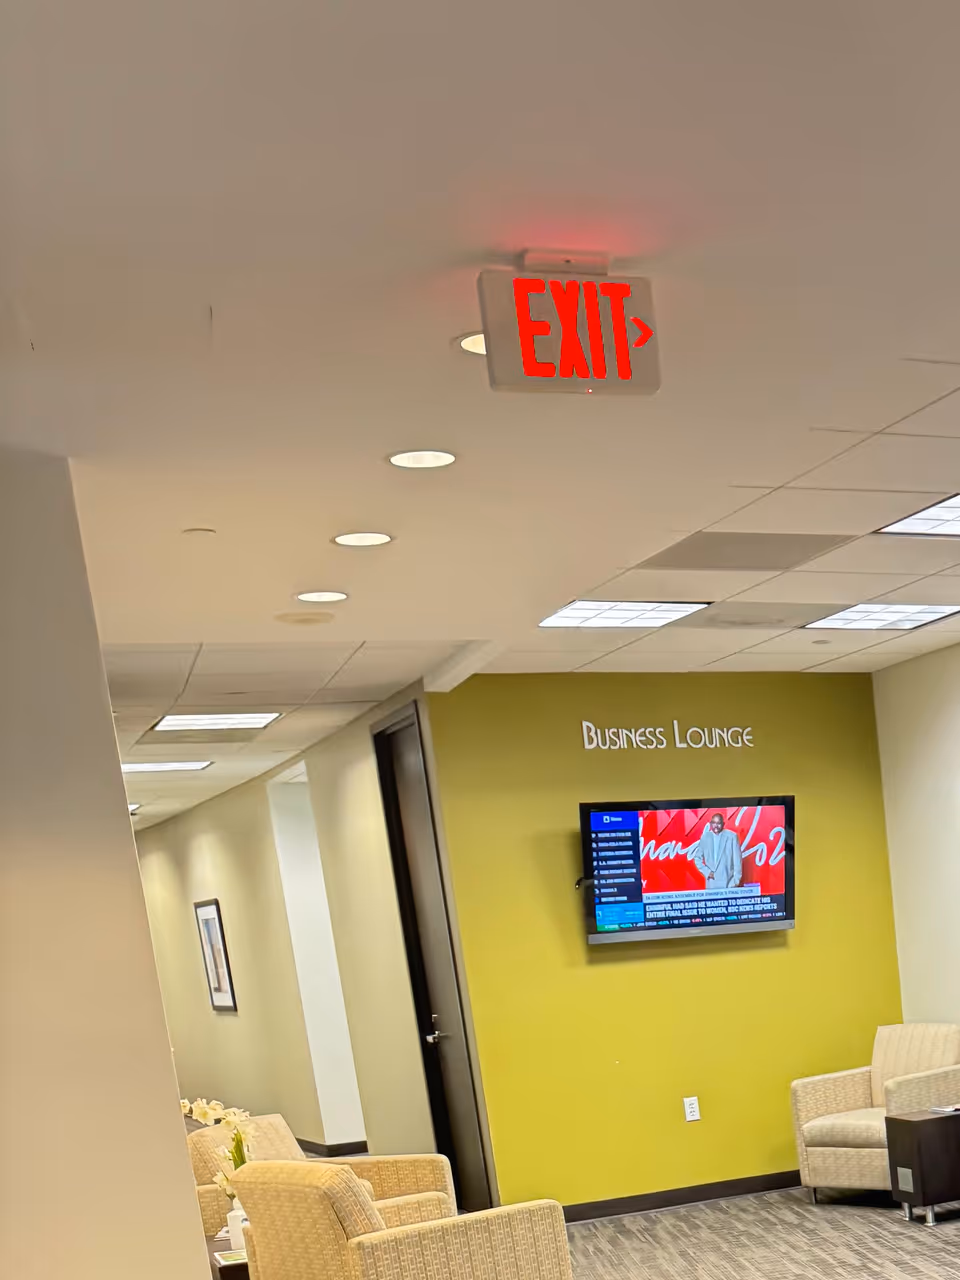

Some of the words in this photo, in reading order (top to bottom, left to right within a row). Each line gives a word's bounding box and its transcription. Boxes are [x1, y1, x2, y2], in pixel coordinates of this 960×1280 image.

[512, 278, 632, 380] EXIT
[581, 720, 667, 750] BUSINESS
[673, 719, 754, 749] LOUNGE
[706, 900, 728, 908] WANTED
